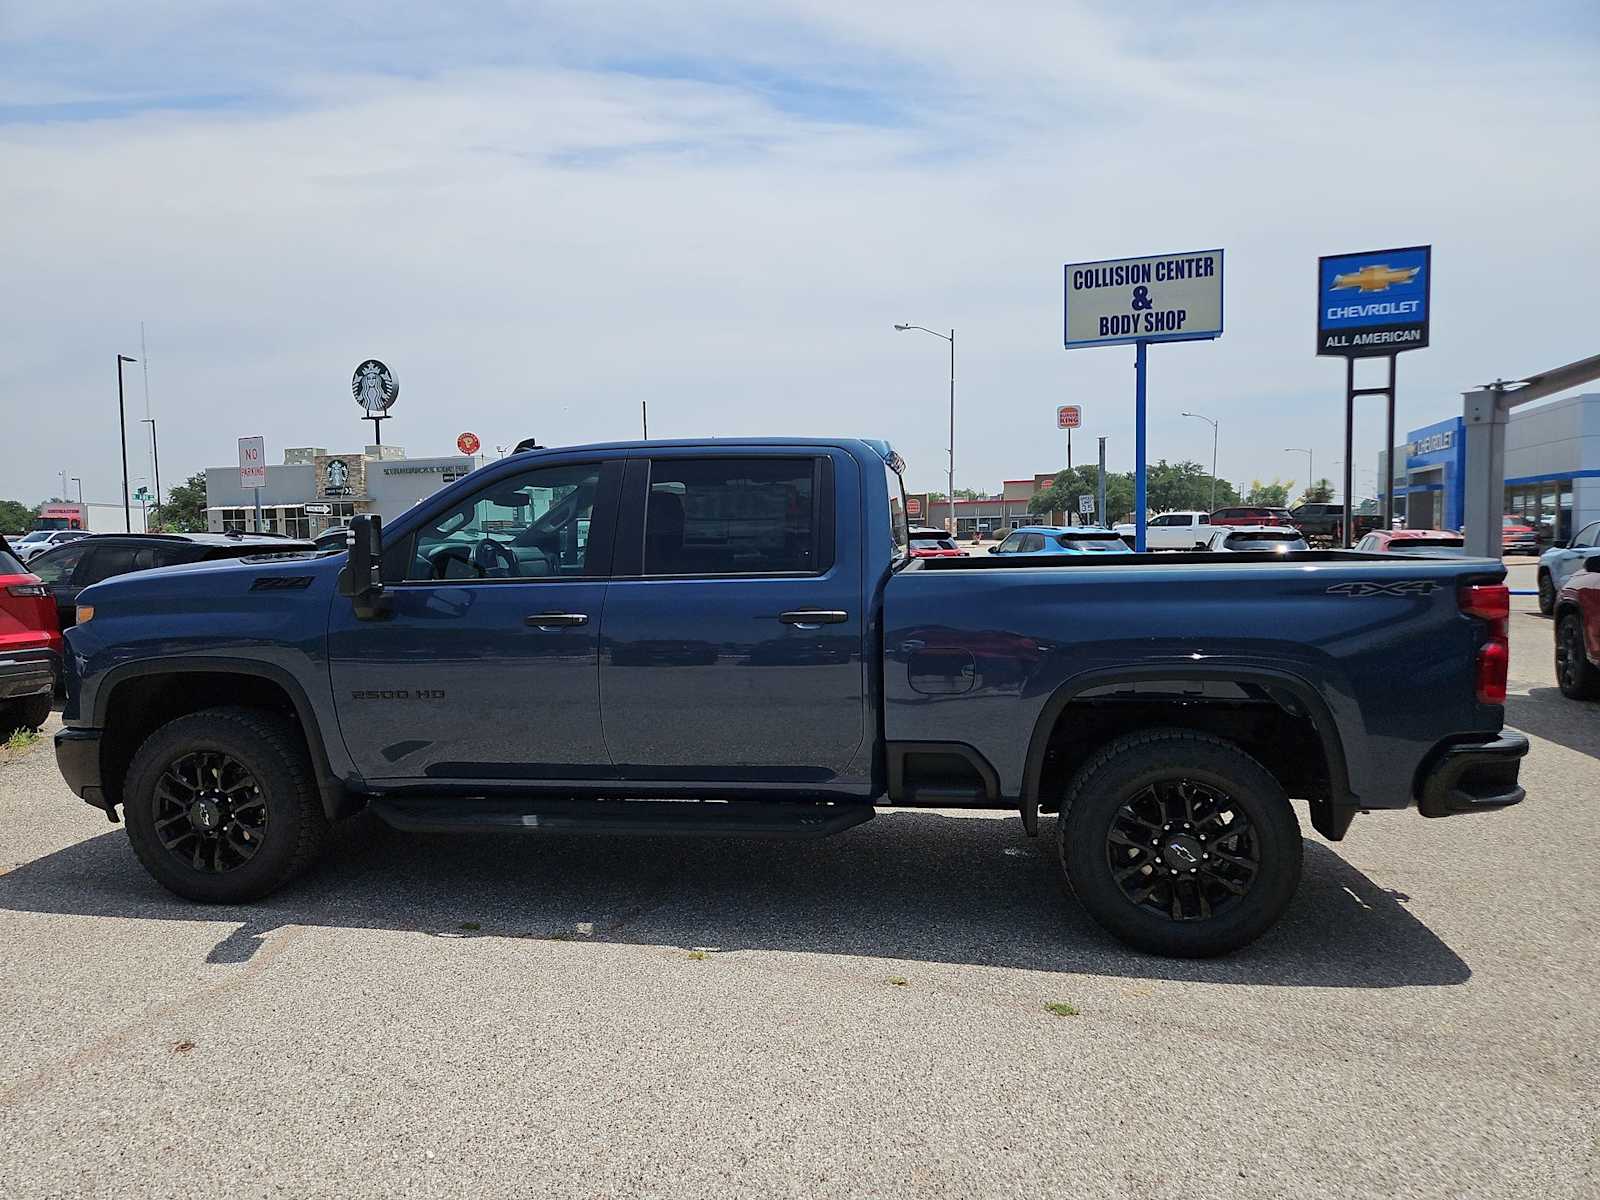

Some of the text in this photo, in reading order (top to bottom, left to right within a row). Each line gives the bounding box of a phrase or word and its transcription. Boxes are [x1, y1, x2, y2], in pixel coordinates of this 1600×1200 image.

[1073, 256, 1214, 290] COLLISION CENTER
[1131, 285, 1153, 311] &
[1327, 300, 1420, 320] CHEVROLET
[1099, 310, 1187, 336] BODY SHOP
[1326, 329, 1421, 347] ALL AMERICAN
[245, 448, 257, 461] NO
[241, 466, 265, 478] PARKING
[1326, 581, 1443, 597] 4X4
[352, 689, 446, 700] 2500 HD
